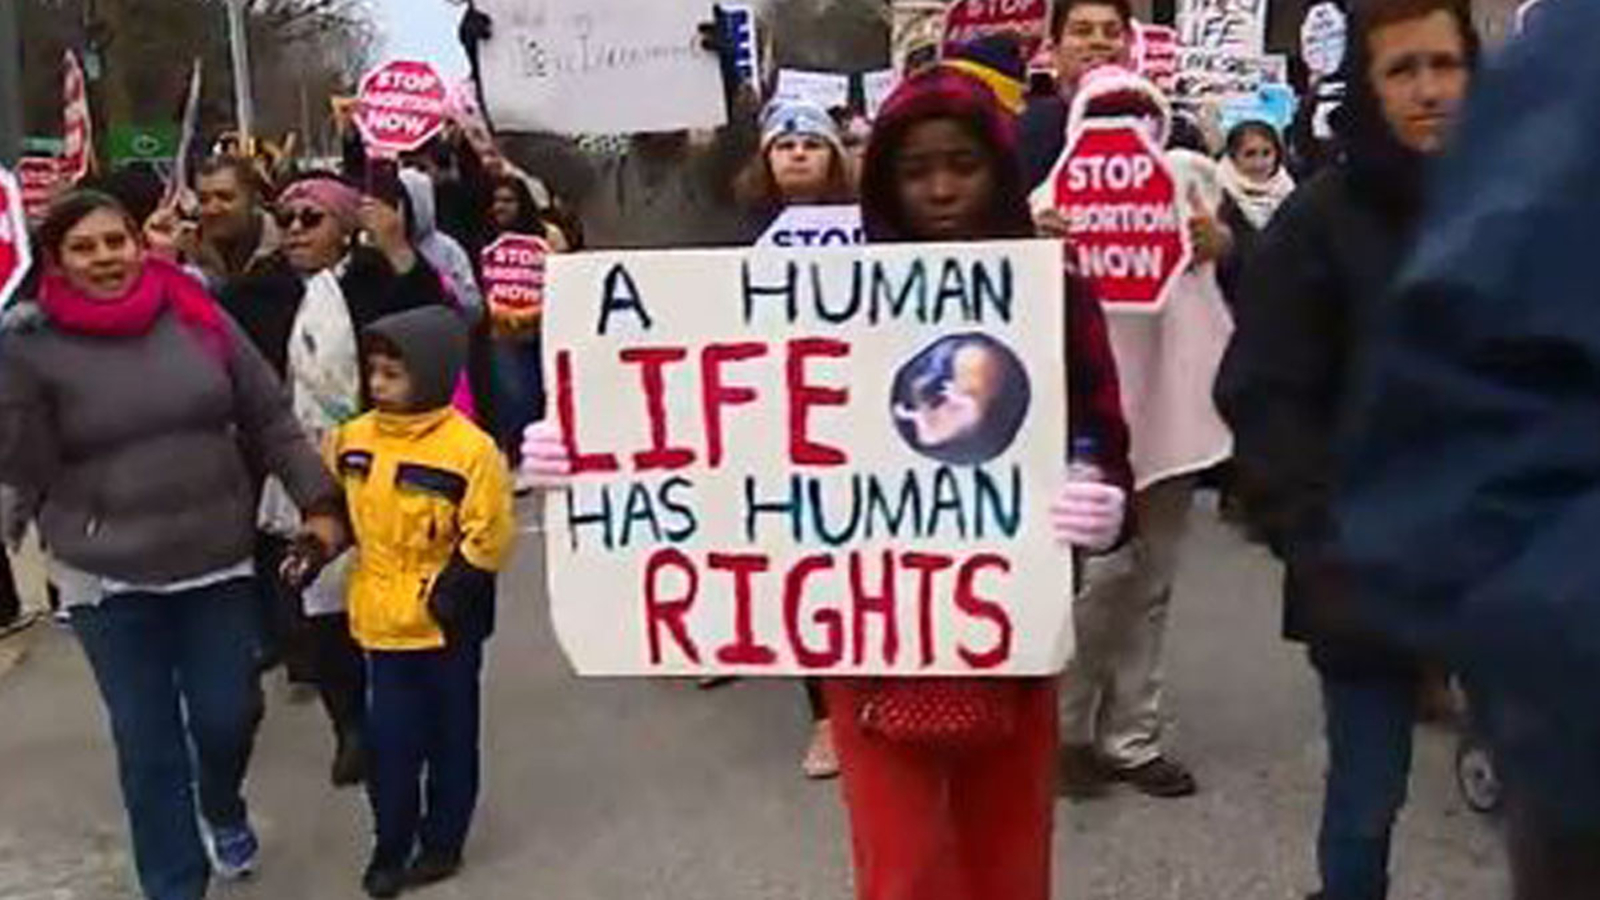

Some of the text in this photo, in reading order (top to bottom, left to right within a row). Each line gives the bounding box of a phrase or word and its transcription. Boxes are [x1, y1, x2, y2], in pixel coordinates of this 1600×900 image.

[377, 71, 437, 92] STOP
[366, 110, 431, 137] NOW
[1067, 154, 1154, 191] STOP
[1076, 245, 1164, 278] NOW
[488, 284, 540, 301] NOW
[597, 257, 1013, 335] A HUMAN
[556, 338, 852, 474] LIFE
[567, 464, 1023, 551] HAS HUMAN
[643, 546, 1012, 669] RIGHTS
